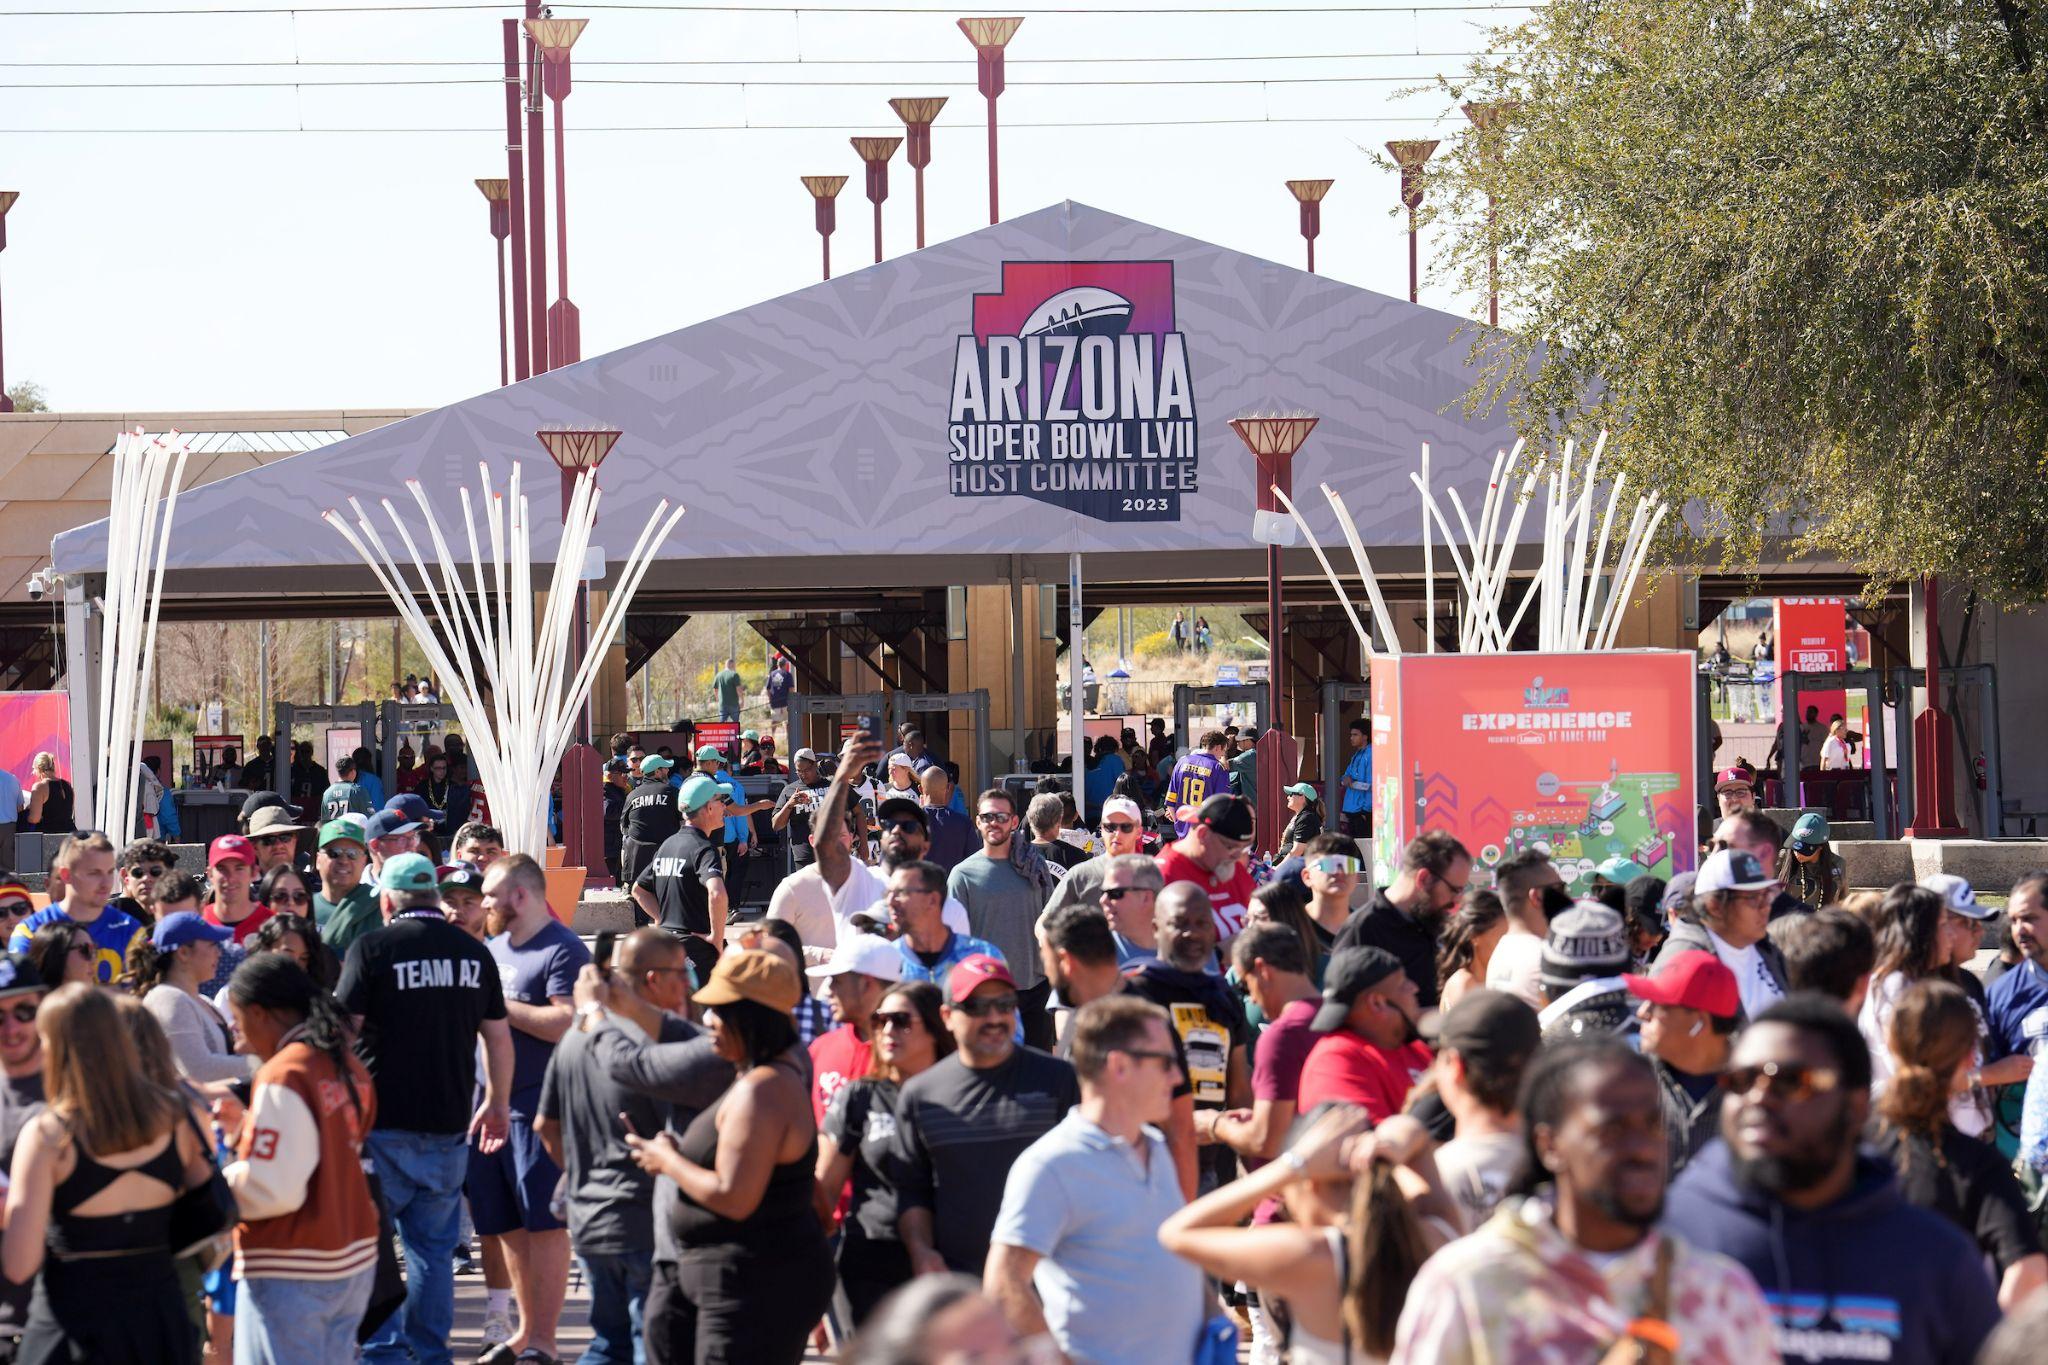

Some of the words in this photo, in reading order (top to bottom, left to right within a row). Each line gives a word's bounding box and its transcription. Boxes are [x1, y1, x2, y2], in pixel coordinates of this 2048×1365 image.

[949, 333, 1194, 422] ARIZONA
[949, 422, 1041, 461] SUPER
[1051, 422, 1133, 460] BOWL
[1140, 421, 1194, 458] LVII
[950, 463, 1022, 493] HOST
[1030, 460, 1198, 492] COMMITTEE
[1121, 498, 1169, 511] 2023
[1793, 662, 1834, 672] LIGHT
[1798, 652, 1829, 663] BUD
[1462, 711, 1632, 731] EXPERIENCE
[1182, 777, 1206, 806] 18
[328, 800, 349, 819] 27
[631, 795, 654, 810] TEAM
[655, 794, 668, 806] AZ
[653, 858, 673, 877] EAM
[392, 959, 454, 990] TEAM
[459, 959, 481, 988] AZ
